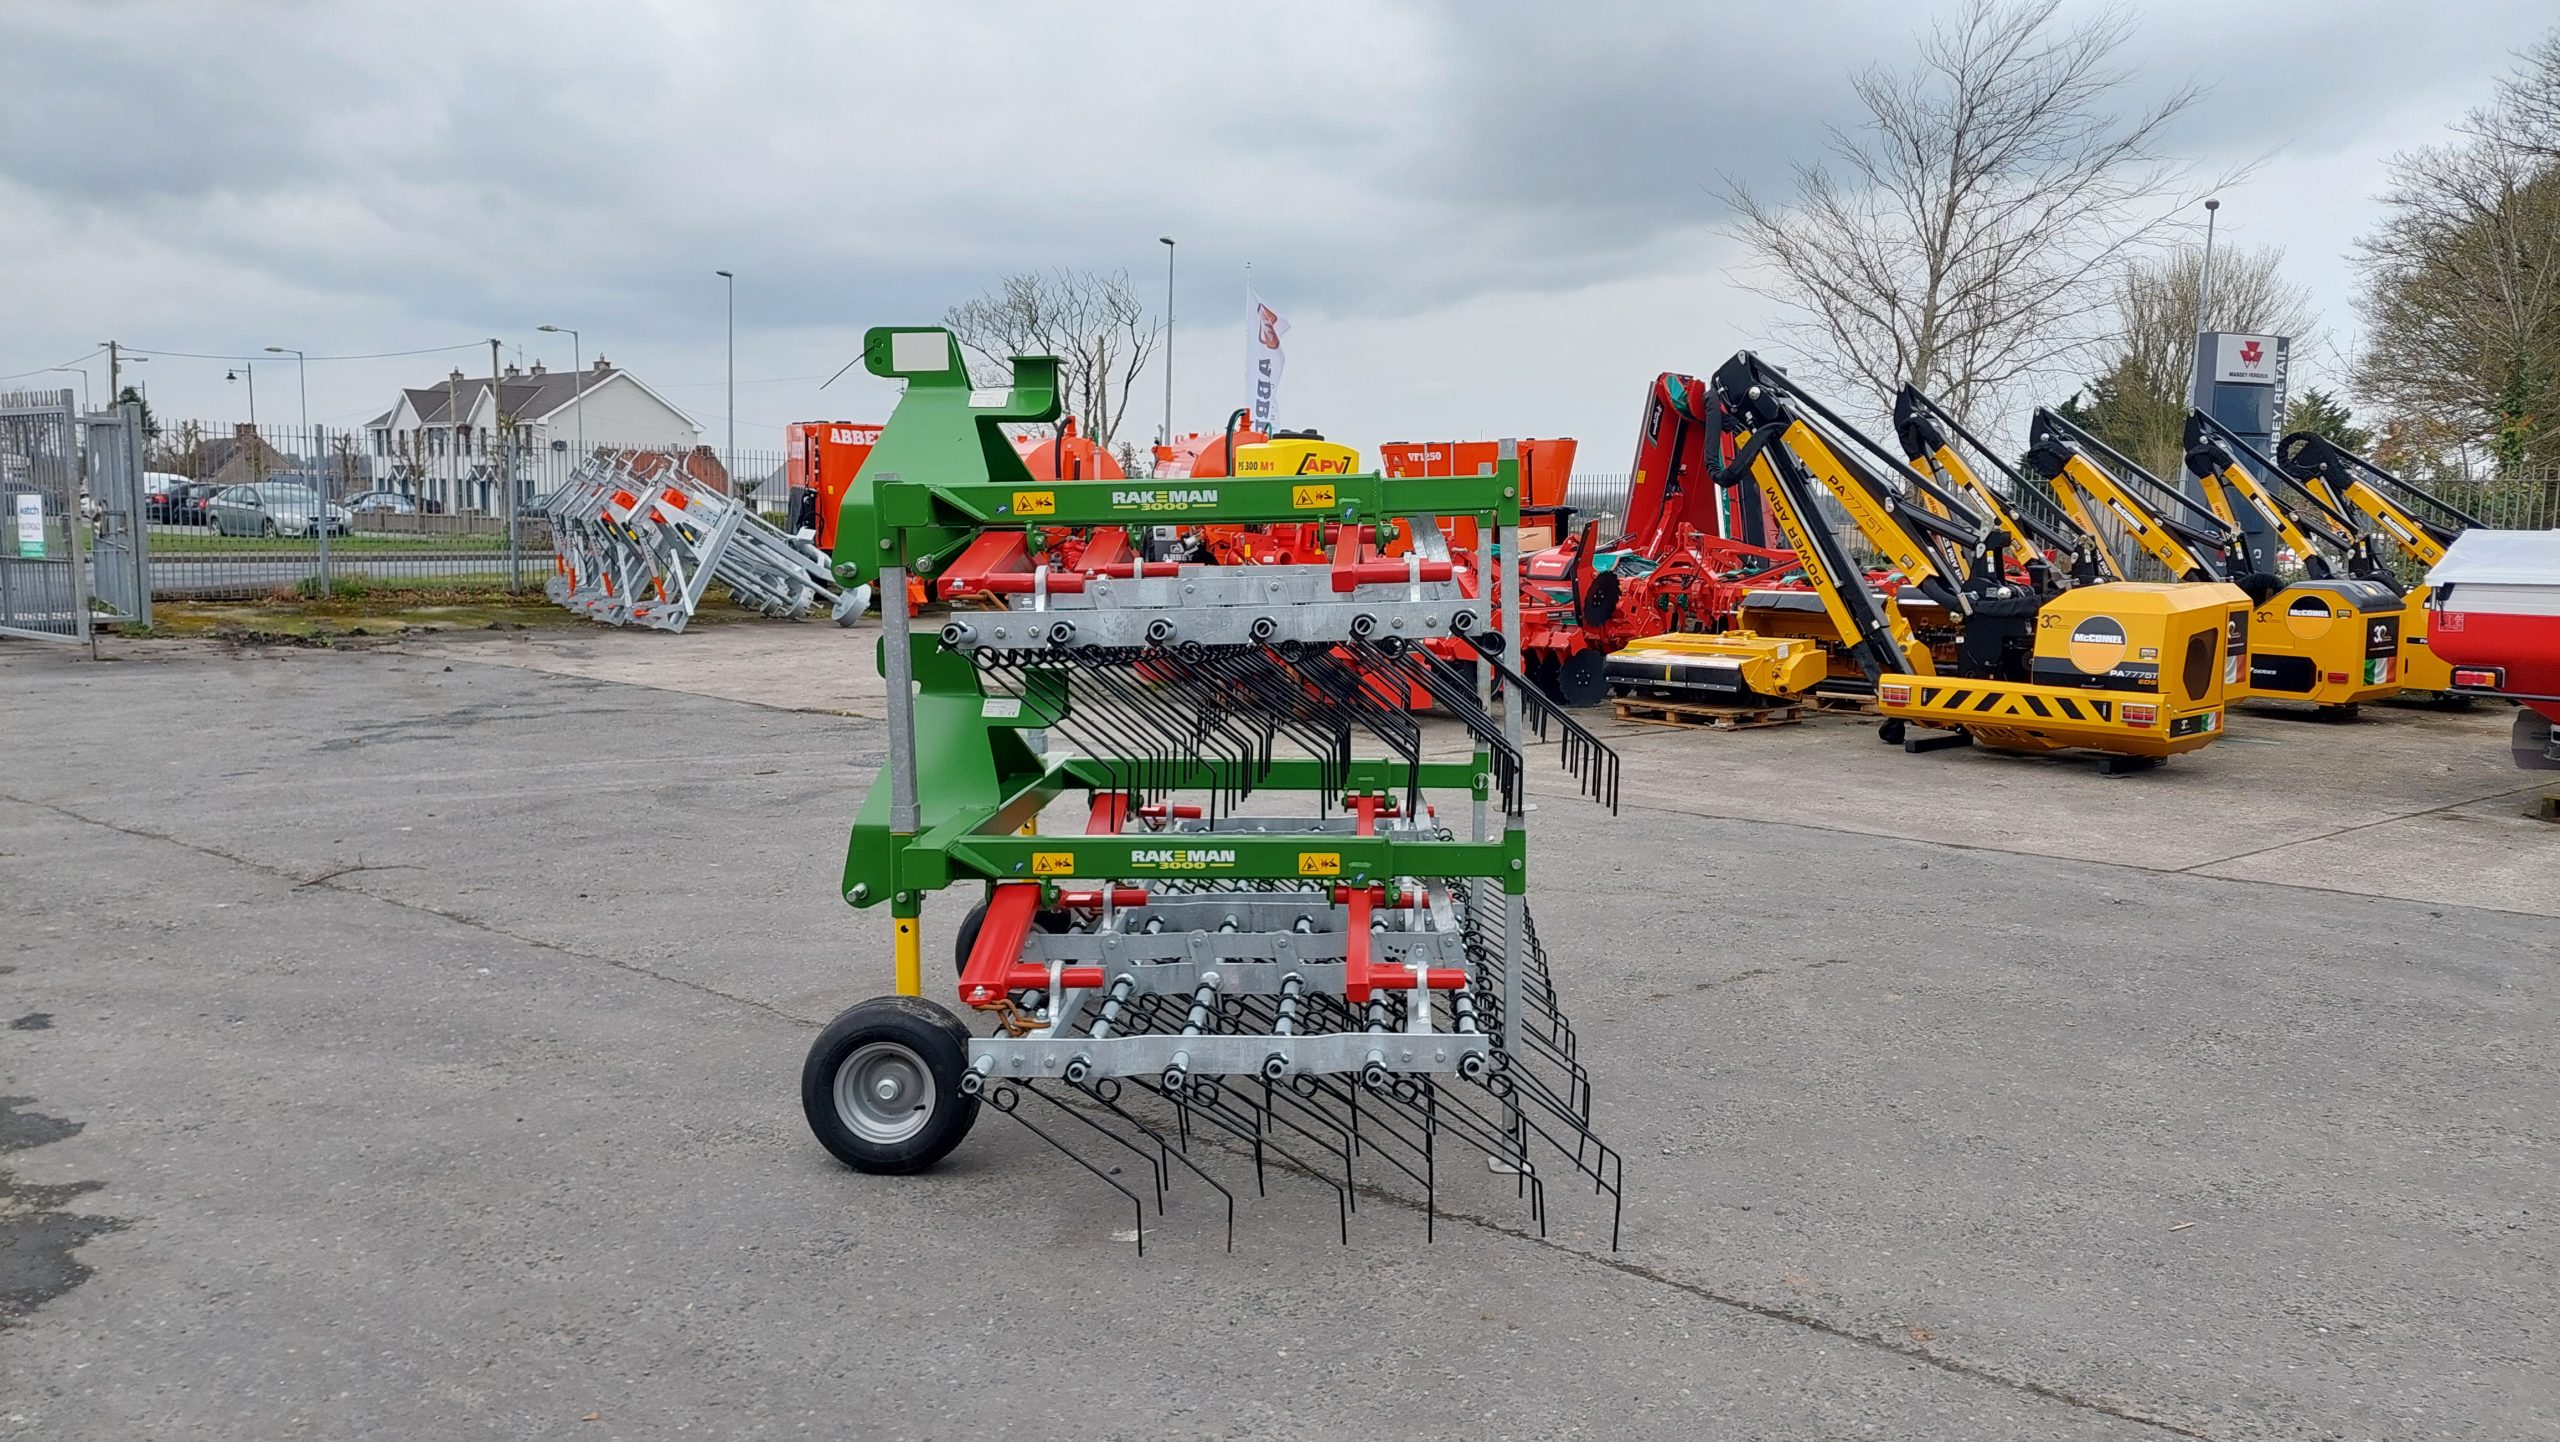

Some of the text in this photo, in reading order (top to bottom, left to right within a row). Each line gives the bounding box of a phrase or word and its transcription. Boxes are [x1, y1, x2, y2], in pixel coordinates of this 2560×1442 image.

[2273, 346, 2287, 404] RETAIL
[1255, 358, 1272, 432] ABBE
[1407, 451, 1442, 462] VF1250
[1245, 461, 1258, 471] 300
[1304, 458, 1346, 474] APV
[1112, 489, 1218, 504] RAKEMAN
[1140, 502, 1189, 511] 3000
[1827, 474, 1885, 535] PA7775T
[1765, 486, 1824, 586] POWER ARM
[1946, 548, 1959, 568] ARM
[2109, 669, 2158, 679] PA7775T
[1131, 849, 1236, 862] RAKEMAN
[1159, 861, 1207, 870] 3000
